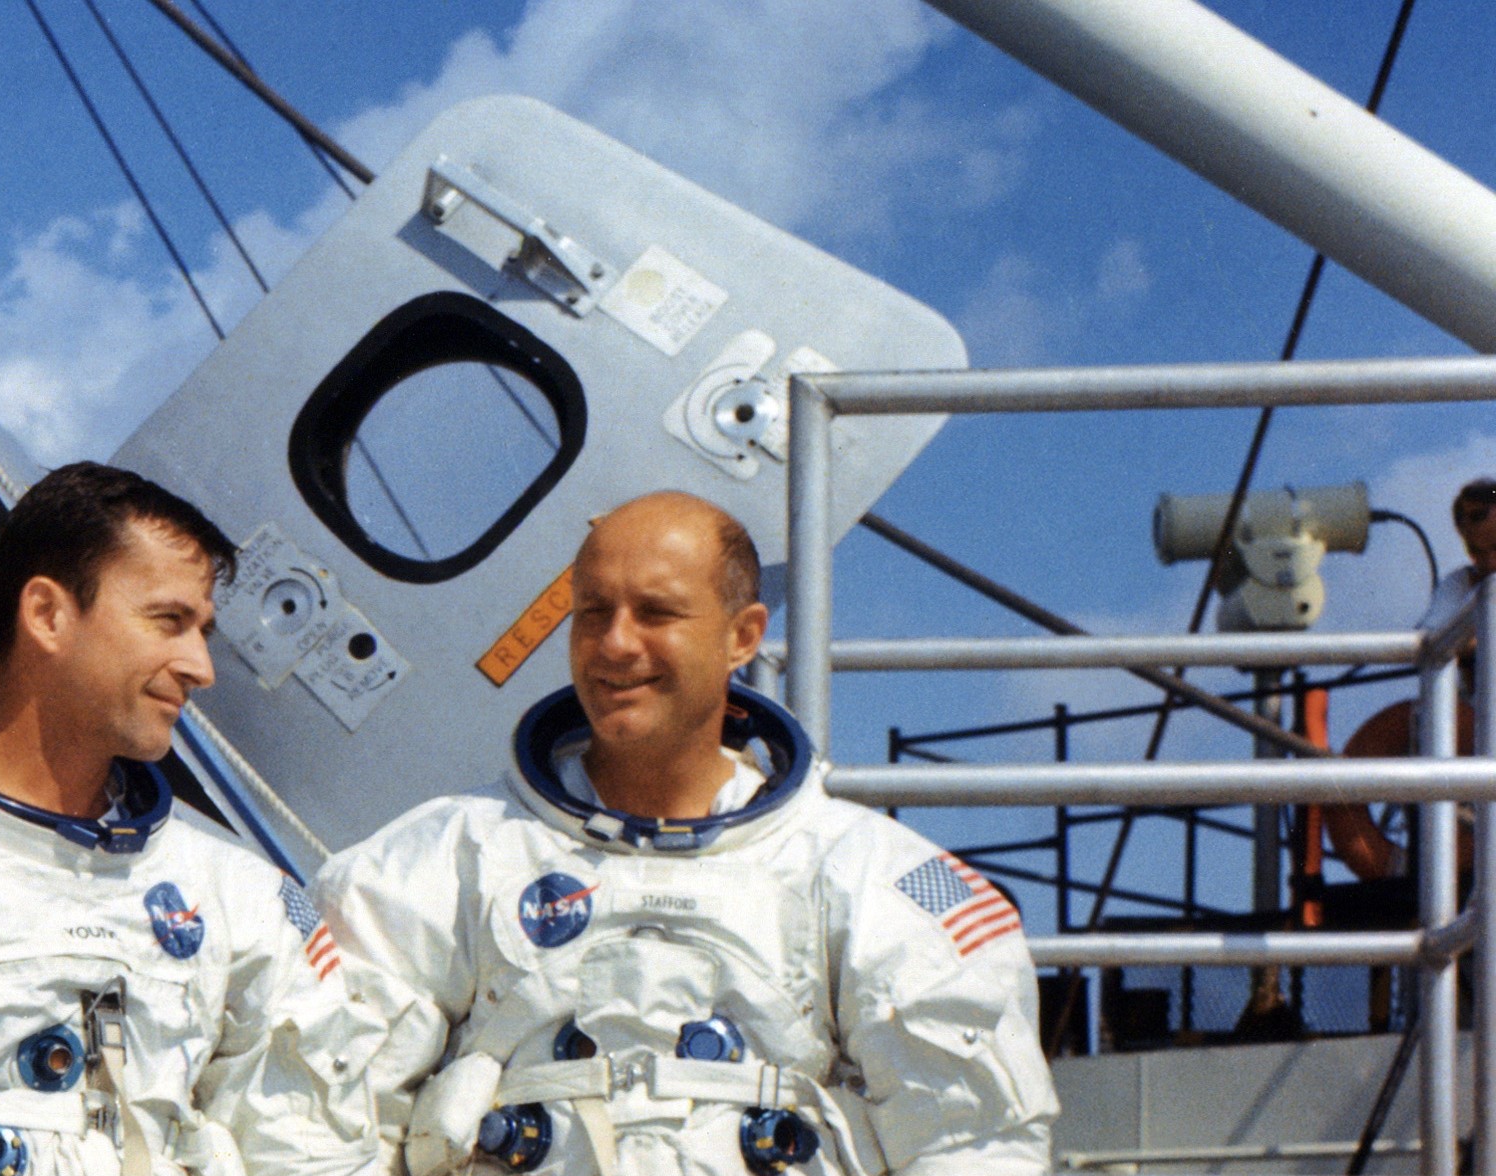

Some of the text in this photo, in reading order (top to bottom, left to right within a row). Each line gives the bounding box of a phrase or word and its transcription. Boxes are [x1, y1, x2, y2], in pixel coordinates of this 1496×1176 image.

[494, 575, 572, 667] RESC
[523, 898, 588, 921] NASA
[641, 895, 697, 910] STAFFORD
